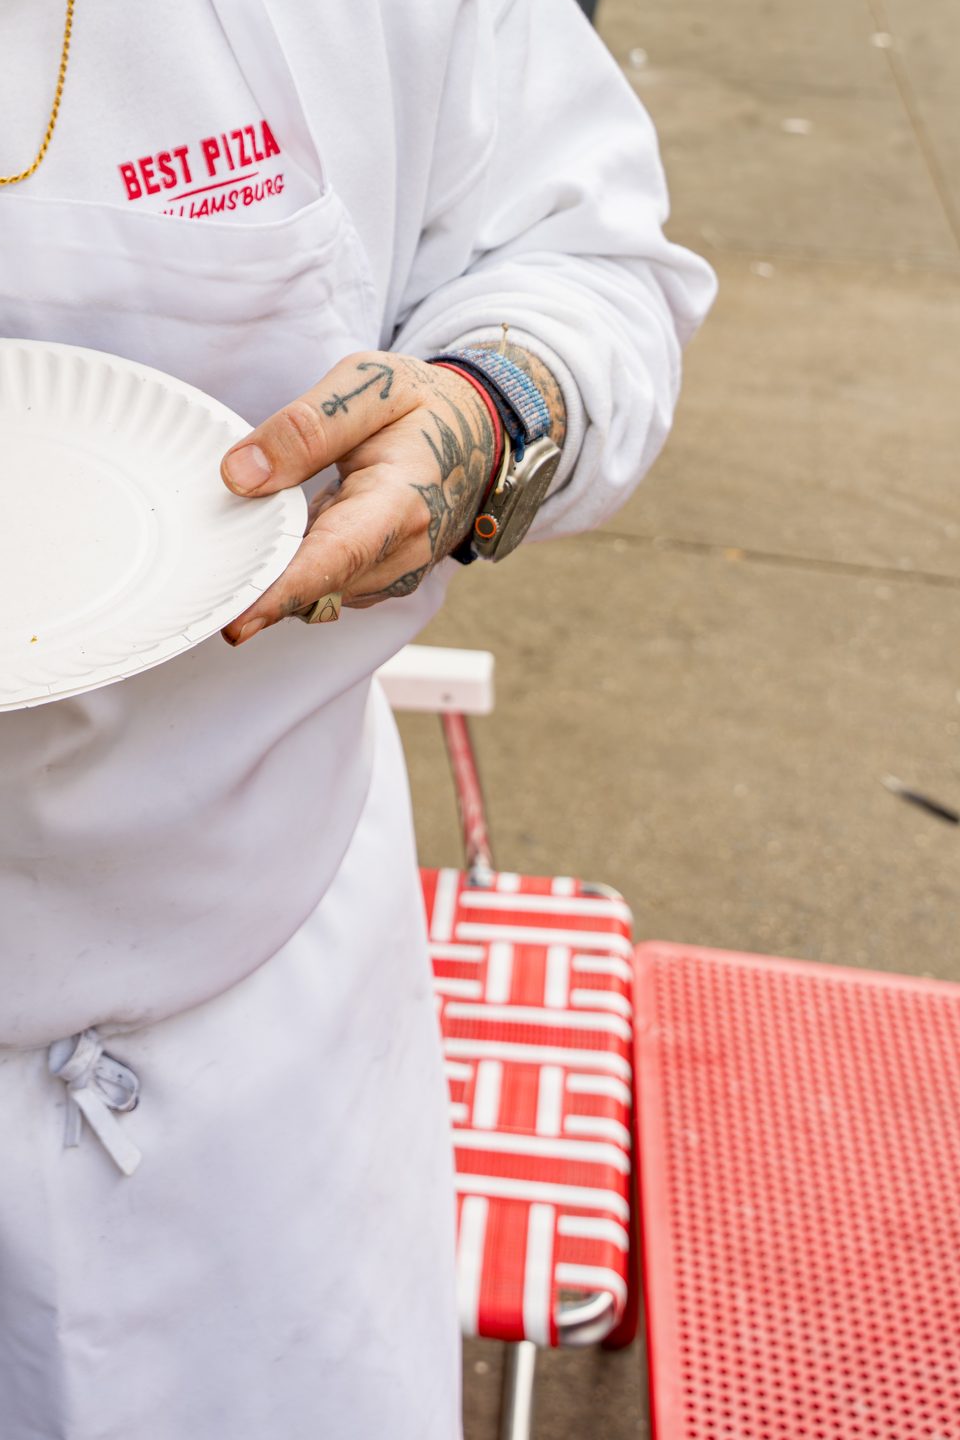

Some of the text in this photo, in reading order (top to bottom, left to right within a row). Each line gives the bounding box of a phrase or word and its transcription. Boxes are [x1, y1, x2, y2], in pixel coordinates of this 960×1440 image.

[117, 118, 282, 201] BEST PIZZA
[159, 172, 286, 219] IAMSBURG
